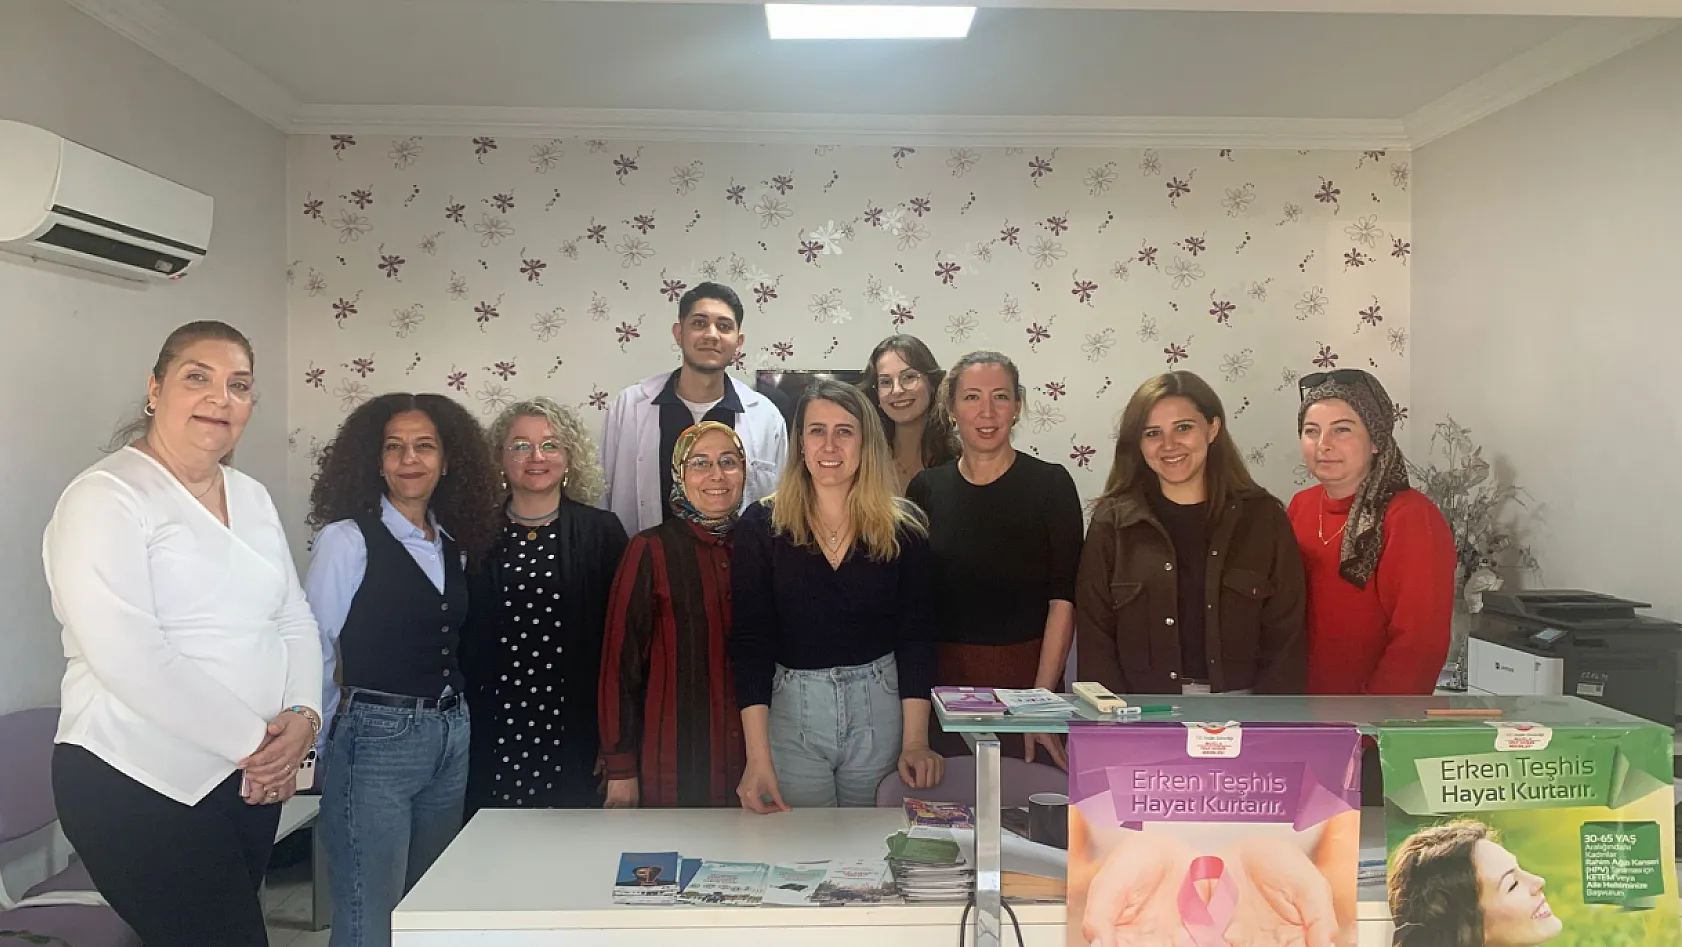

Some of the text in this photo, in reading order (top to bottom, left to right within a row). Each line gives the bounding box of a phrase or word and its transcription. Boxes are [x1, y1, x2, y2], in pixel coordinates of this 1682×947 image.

[1441, 755, 1595, 781] Erken Teşhis
[1132, 769, 1287, 796] Erken Teşhis
[1442, 782, 1596, 807] Hayat Kurtarır.
[1132, 794, 1285, 818] Hayat Kurtarır.
[1584, 834, 1637, 846] 30-65 YAŞ
